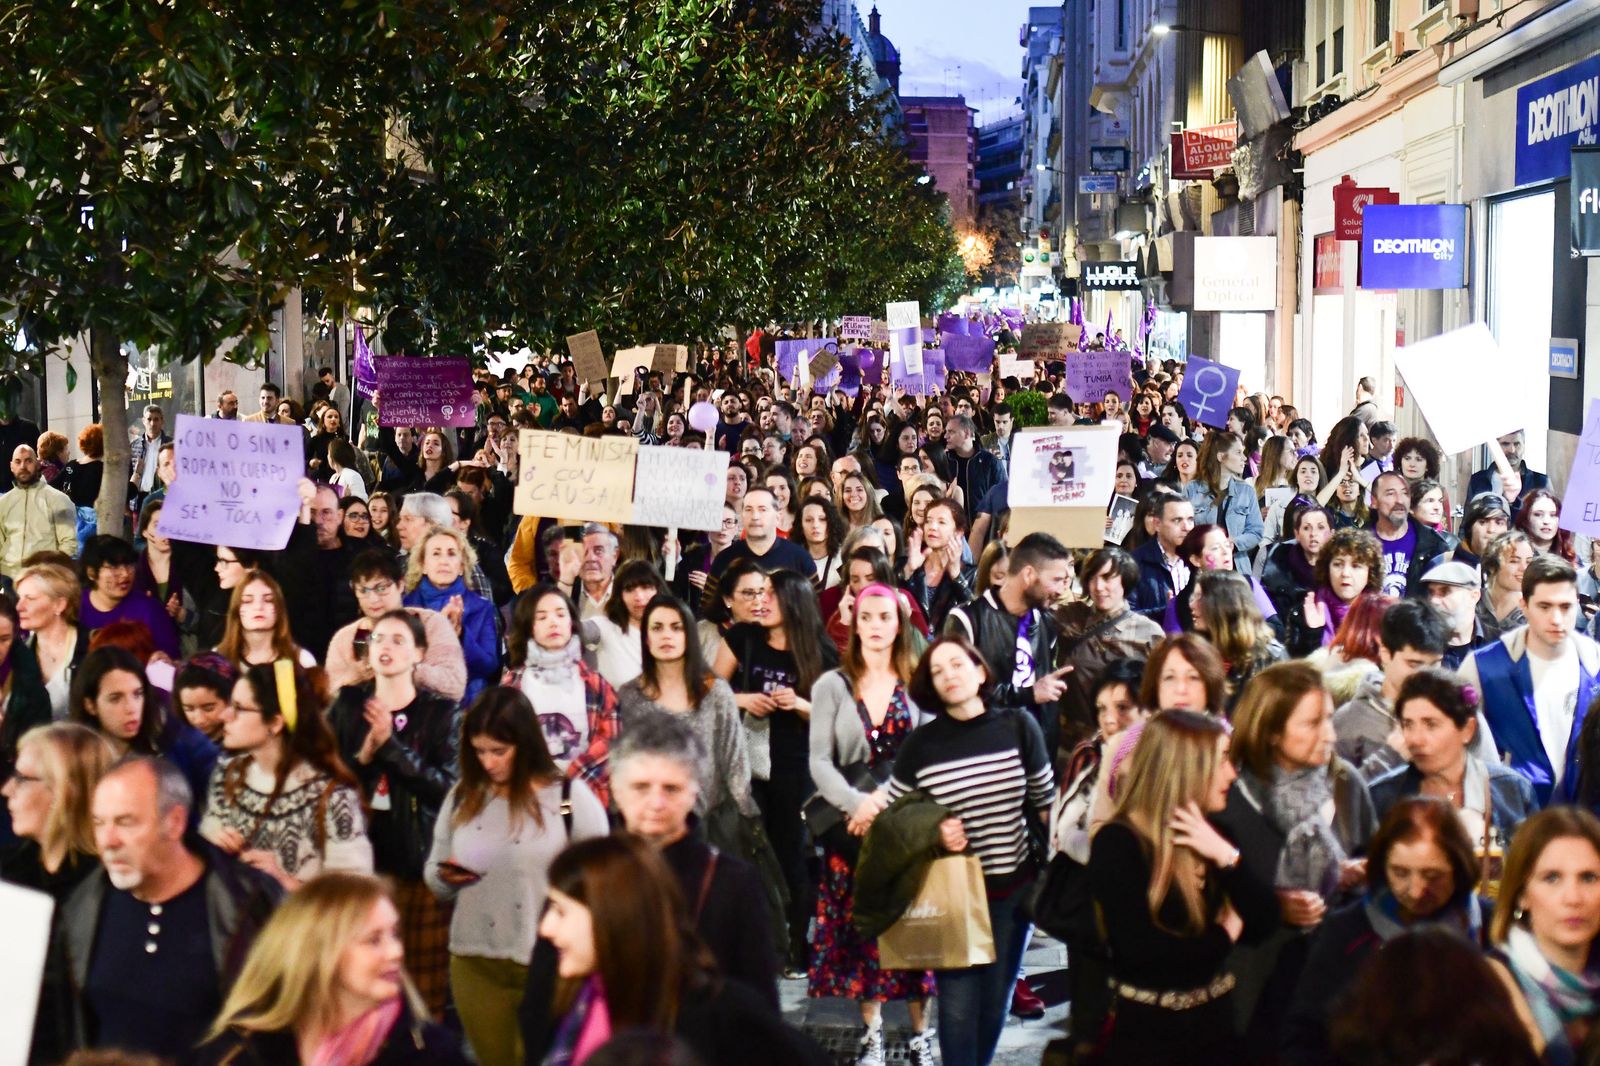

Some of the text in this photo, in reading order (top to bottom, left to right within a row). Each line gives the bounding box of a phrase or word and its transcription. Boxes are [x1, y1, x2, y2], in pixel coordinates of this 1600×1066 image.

[1528, 75, 1599, 146] DECATHLON
[1189, 155, 1205, 165] 957
[1373, 238, 1455, 254] DECATHLON
[1086, 266, 1136, 277] LUQUE
[1202, 275, 1259, 289] General
[860, 330, 870, 338] VOZ
[1552, 353, 1573, 368] DECATHLON
[1084, 374, 1112, 384] TUMBA
[185, 430, 276, 454] CON O SIN
[527, 434, 638, 464] FEMINISTA
[1035, 442, 1062, 454] AMOR
[182, 457, 287, 482] ROPA MI CUERPO
[220, 481, 241, 499] NO
[1051, 485, 1062, 494] NO
[180, 504, 261, 525] SE TOCA
